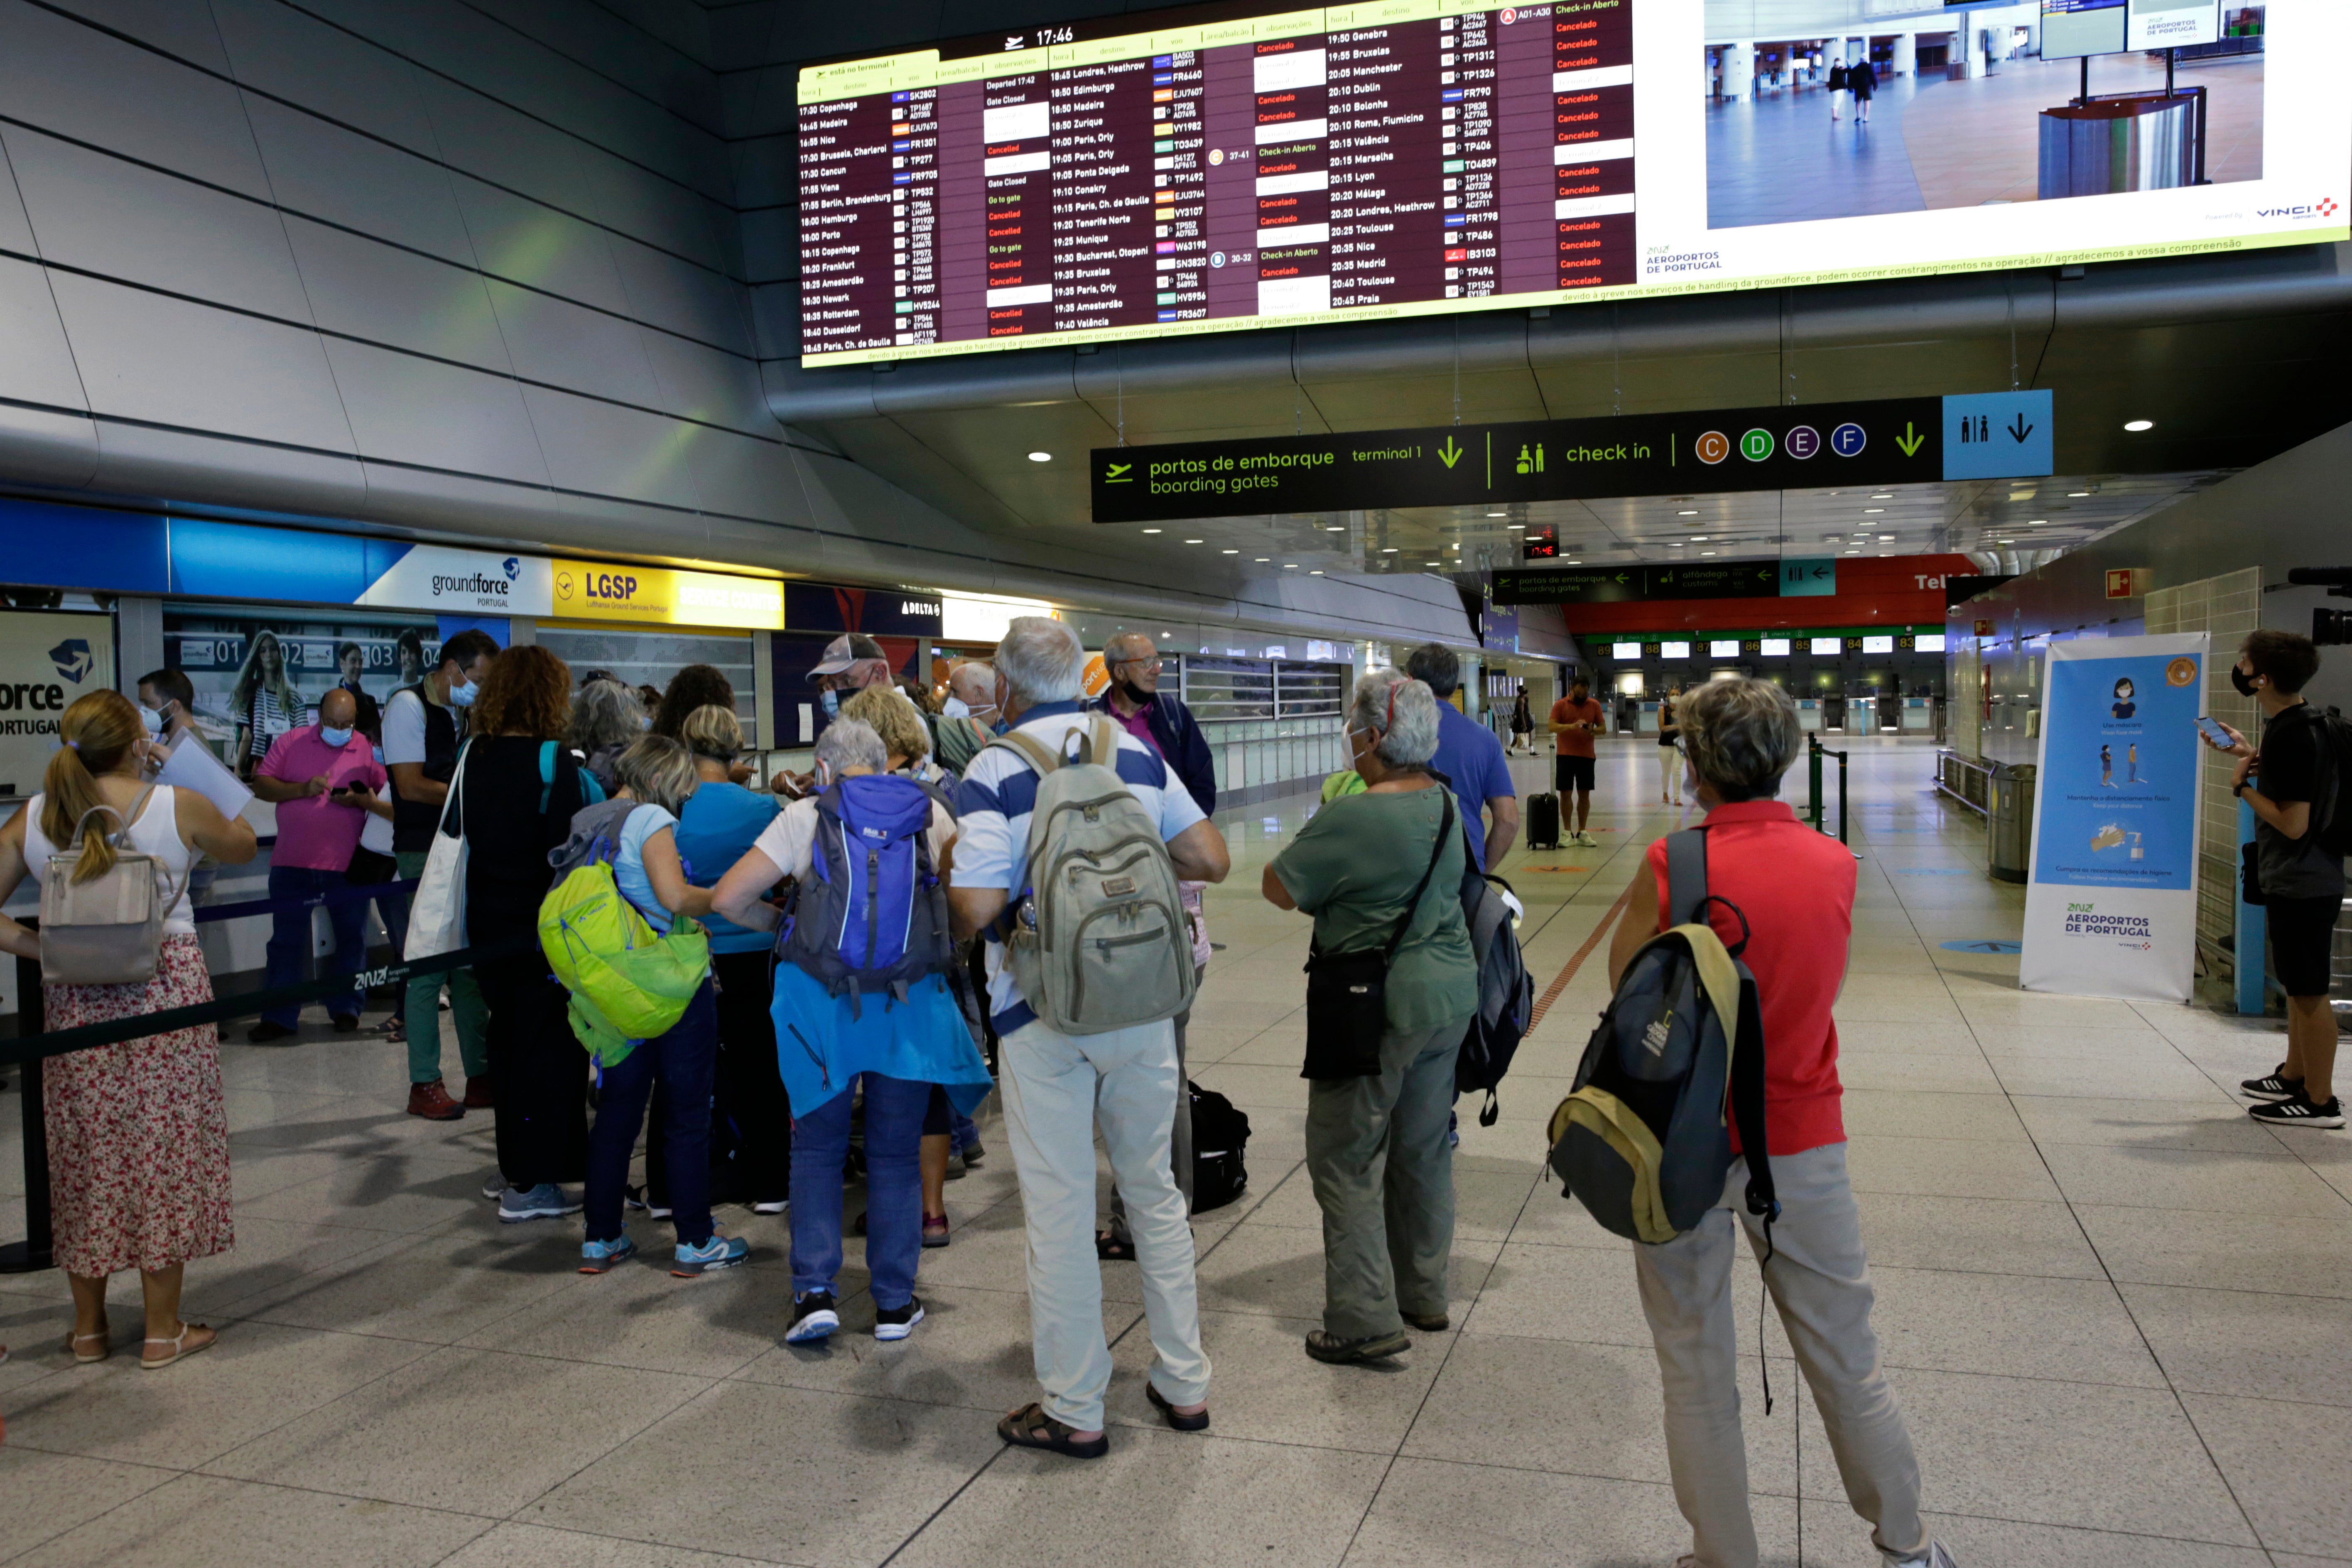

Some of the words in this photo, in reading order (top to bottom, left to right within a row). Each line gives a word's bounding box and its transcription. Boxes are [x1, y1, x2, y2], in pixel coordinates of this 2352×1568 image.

[1518, 7, 1551, 19] A01-A30
[1556, 2, 1591, 15] Check-in
[1592, 0, 1619, 10] Aberto
[1504, 11, 1512, 21] A
[1328, 33, 1350, 44] 19:50
[1352, 29, 1388, 42] Genebra
[1462, 12, 1486, 23] TP946
[2148, 20, 2195, 30] AEROPORTOS
[2159, 25, 2197, 34] PORTUGAL
[1037, 27, 1073, 46] 17:46
[830, 65, 845, 76] está
[858, 60, 889, 71] terminal
[844, 82, 867, 91] destino
[940, 66, 979, 77] área/balcão
[994, 59, 1037, 69] observações
[986, 78, 1016, 91] Departed
[1018, 75, 1035, 86] 17:42
[799, 105, 818, 116] 17:30
[819, 101, 858, 114] Copenhaga
[909, 88, 937, 101] SK2802
[1230, 150, 1249, 160] 37-41
[1259, 146, 1291, 157] Check-in
[1292, 144, 1316, 153] Aberto
[1052, 169, 1073, 181] 19:05
[1074, 168, 1097, 179] Ponta
[1098, 164, 1130, 177] Delgada
[1174, 152, 1195, 163] S4127
[1260, 197, 1297, 209] Cancelado
[1053, 220, 1074, 231] 19:20
[1075, 216, 1107, 228] Tenerife
[1109, 214, 1131, 225] Norte
[1175, 206, 1203, 218] VY3107
[2257, 206, 2310, 217] VINCI
[1560, 239, 1601, 250] Cancelado
[1332, 260, 1354, 272] 20:35
[1356, 257, 1386, 269] Madrid
[1465, 247, 1496, 260] IB3103
[1647, 252, 1719, 264] AEROPORTOS
[1562, 292, 1590, 301] devido
[1600, 290, 1625, 301] greve
[1646, 286, 1683, 294] serviços
[1699, 281, 1738, 292] handling
[1741, 279, 1751, 287] da
[1754, 275, 1814, 288] groundforce,
[1816, 272, 1849, 282] podem
[1851, 269, 1887, 278] ocorrer
[1889, 262, 1978, 275] constrangimentos
[1995, 256, 2042, 267] operação
[2055, 250, 2124, 262] agradecemos
[2136, 247, 2166, 255] vossa
[2168, 239, 2242, 253] compreensão
[1665, 261, 1722, 272] PORTUGAL
[989, 275, 1022, 286] Cancelled
[802, 295, 821, 306] 18:30
[822, 293, 850, 304] Newark
[912, 283, 935, 295] TP207
[1750, 434, 1766, 455] D
[1795, 432, 1810, 453] E
[1842, 429, 1856, 450] F
[1352, 447, 1412, 462] terminal
[1417, 447, 1421, 458] 1
[1567, 445, 1628, 463] check
[1631, 443, 1651, 460] in
[1704, 439, 1720, 458] C
[1150, 458, 1207, 478] portas
[1212, 455, 1234, 472] de
[1240, 451, 1334, 470] embarque
[1150, 476, 1226, 494] boarding
[1231, 474, 1278, 493] gates
[1531, 546, 1553, 556] 17:46
[1562, 575, 1606, 584] embarque
[1682, 569, 1728, 580] alfândega
[1915, 574, 1953, 589] Tel
[433, 572, 508, 596] groundforce
[586, 573, 637, 600] LGSP
[1519, 585, 1555, 593] boarding
[1557, 584, 1580, 592] gates
[1682, 580, 1718, 588] customs
[478, 598, 509, 608] PORTUGAL
[679, 586, 729, 608] SERVICE
[731, 591, 781, 611] COUNTER
[586, 600, 610, 609] Lufthansa
[611, 602, 629, 611] Ground
[630, 603, 649, 612] Services
[650, 604, 668, 613] Portugal
[910, 602, 933, 616] DELTA
[1646, 644, 1659, 654] 88
[1697, 642, 1710, 652] 87
[1745, 641, 1760, 651] 86
[1796, 640, 1810, 650] 85
[1847, 638, 1861, 648] 84
[1900, 637, 1914, 648] 83
[216, 641, 240, 663] 01
[280, 643, 302, 664] 02
[371, 645, 394, 665] 03
[1598, 645, 1611, 655] 89
[1081, 662, 1106, 692] portwa
[2066, 914, 2149, 926] AEROPORTOS
[2065, 923, 2081, 932] DE
[2085, 924, 2151, 937] PORTUGAL
